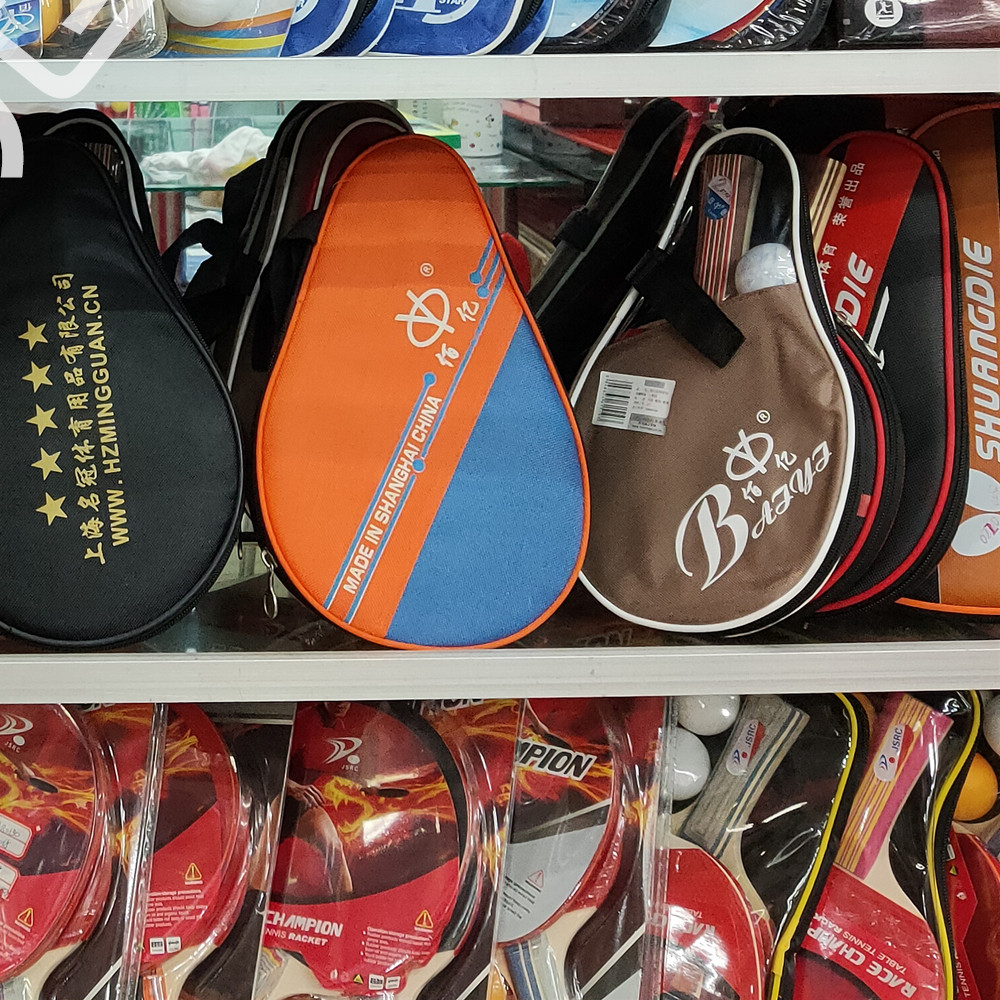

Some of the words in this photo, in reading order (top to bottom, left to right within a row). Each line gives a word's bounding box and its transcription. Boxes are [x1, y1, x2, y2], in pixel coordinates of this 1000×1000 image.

[829, 160, 867, 228] 荣誉出品
[842, 251, 875, 329] DIE
[962, 237, 1000, 463] SHUANGDIE
[51, 272, 107, 565] 上海名冠体育用品有限公司
[81, 283, 131, 547] WWW.HZMINGGUAN.CN
[410, 395, 443, 450] CHINA
[375, 448, 419, 526] SHANGHAI
[366, 520, 385, 541] IN
[343, 540, 377, 596] MADE
[4, 739, 22, 754] JSRC
[743, 722, 758, 750] JSRC
[891, 726, 904, 753] JSRC
[264, 928, 287, 940] NNIS
[287, 933, 329, 947] RACKET
[266, 909, 344, 938] CHAMPION
[842, 931, 883, 959] TENNIS
[876, 953, 908, 975] TABLE
[865, 957, 918, 999] RACE
